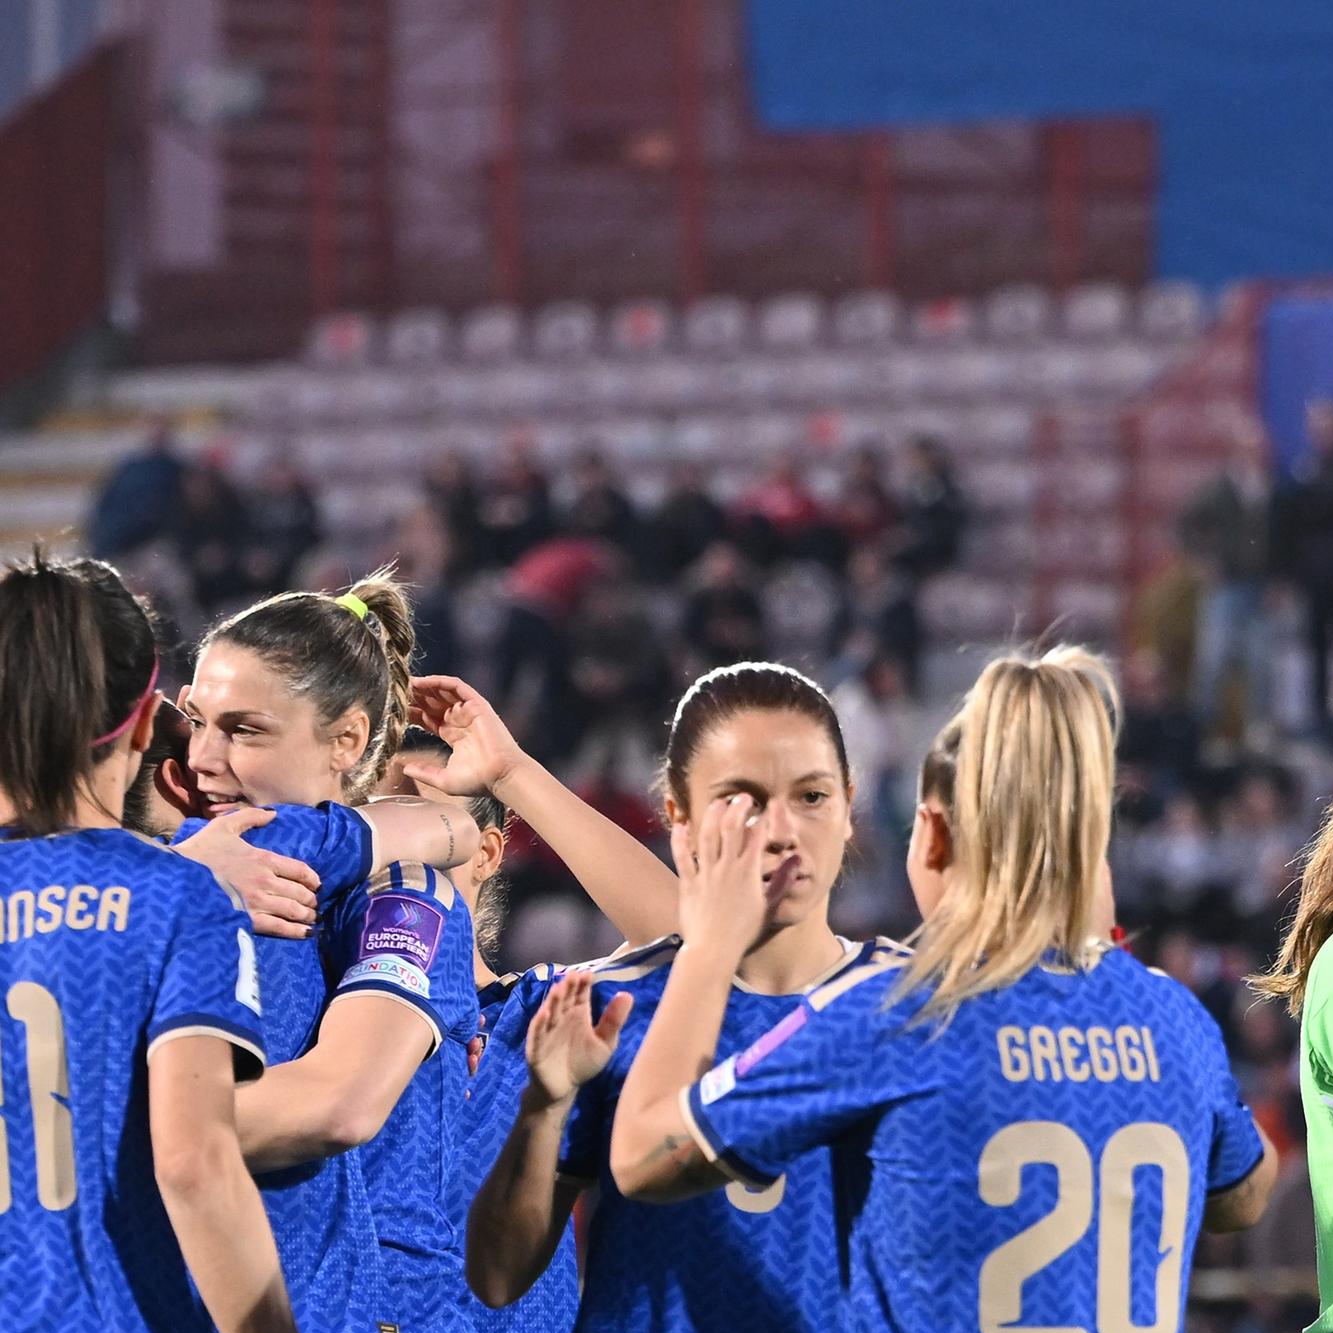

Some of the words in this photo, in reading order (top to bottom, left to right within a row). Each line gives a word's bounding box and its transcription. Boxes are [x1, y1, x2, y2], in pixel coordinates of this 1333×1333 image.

[0, 884, 131, 944] NSEA
[368, 933, 430, 952] EUROPEAN
[365, 942, 429, 962] QUALIFIERS
[996, 1025, 1161, 1083] GREGGI
[0, 980, 77, 1215] 1
